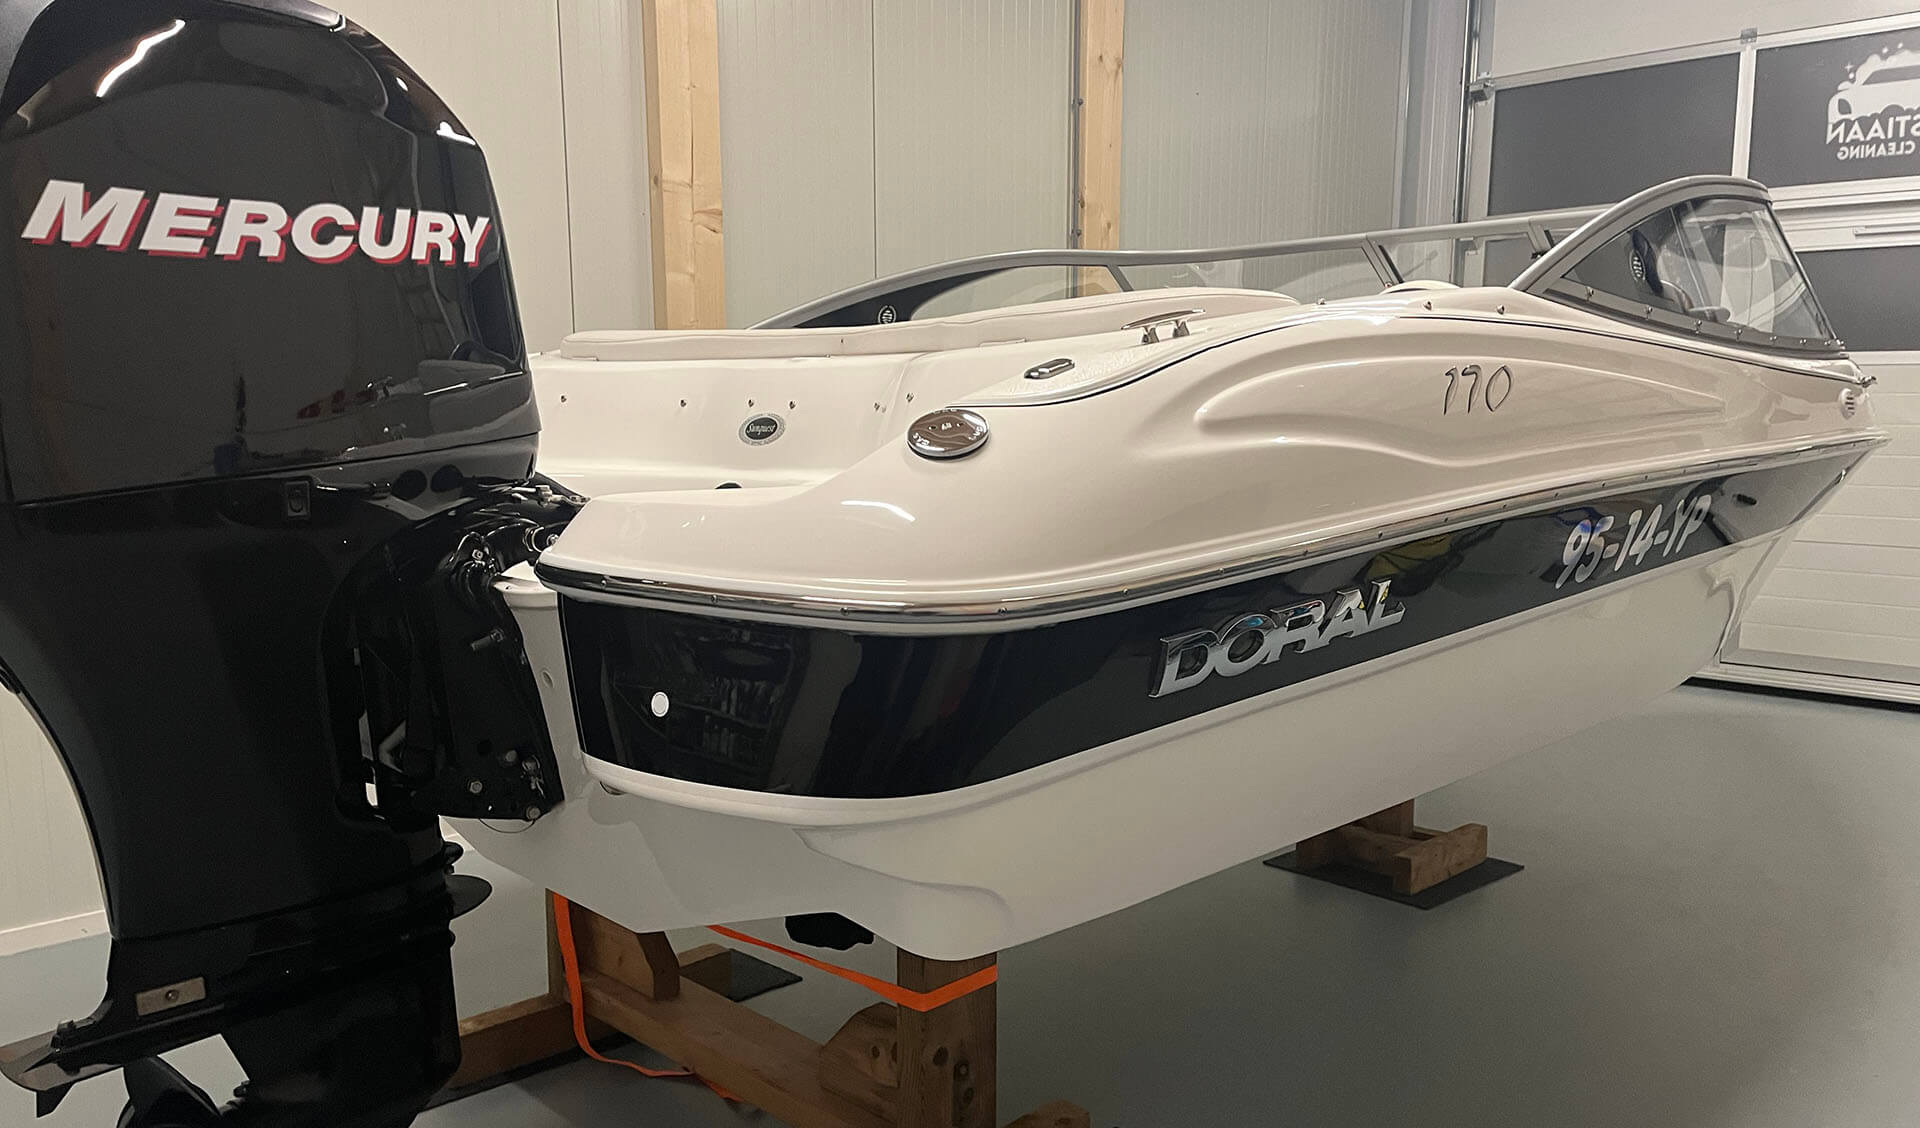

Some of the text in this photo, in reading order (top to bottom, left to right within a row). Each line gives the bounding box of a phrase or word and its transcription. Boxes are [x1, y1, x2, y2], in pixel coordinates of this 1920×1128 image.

[21, 179, 490, 267] MERCURY
[1555, 494, 1712, 589] 95-14-YP
[1148, 579, 1406, 698] DORAL
